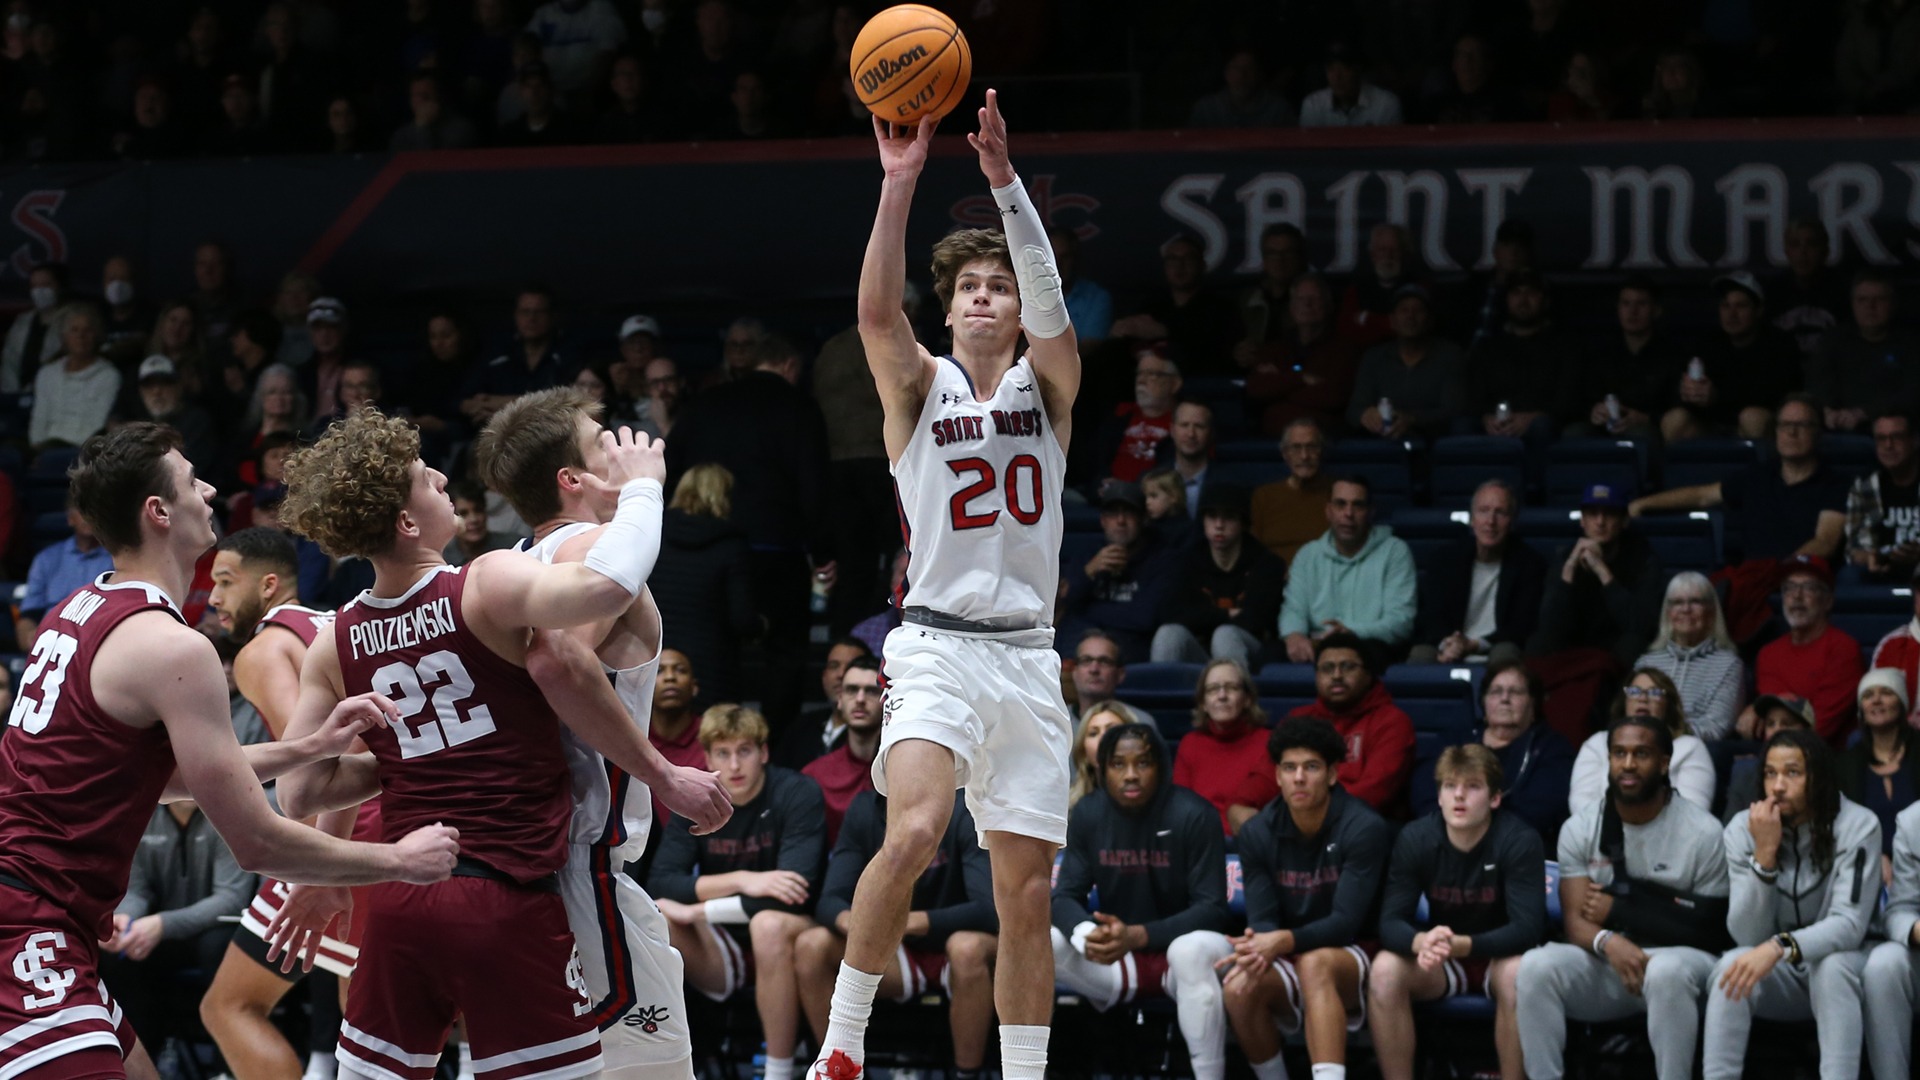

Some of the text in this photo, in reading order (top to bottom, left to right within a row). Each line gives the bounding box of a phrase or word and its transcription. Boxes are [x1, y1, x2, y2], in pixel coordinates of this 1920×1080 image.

[859, 44, 928, 94] Wilson
[896, 83, 935, 116] EVO
[1160, 168, 1535, 274] SAINT
[931, 416, 984, 447] SAINT
[945, 454, 1044, 531] 20
[350, 596, 456, 661] PODZIEMSKI
[7, 628, 79, 736] 23
[371, 649, 498, 760] 22
